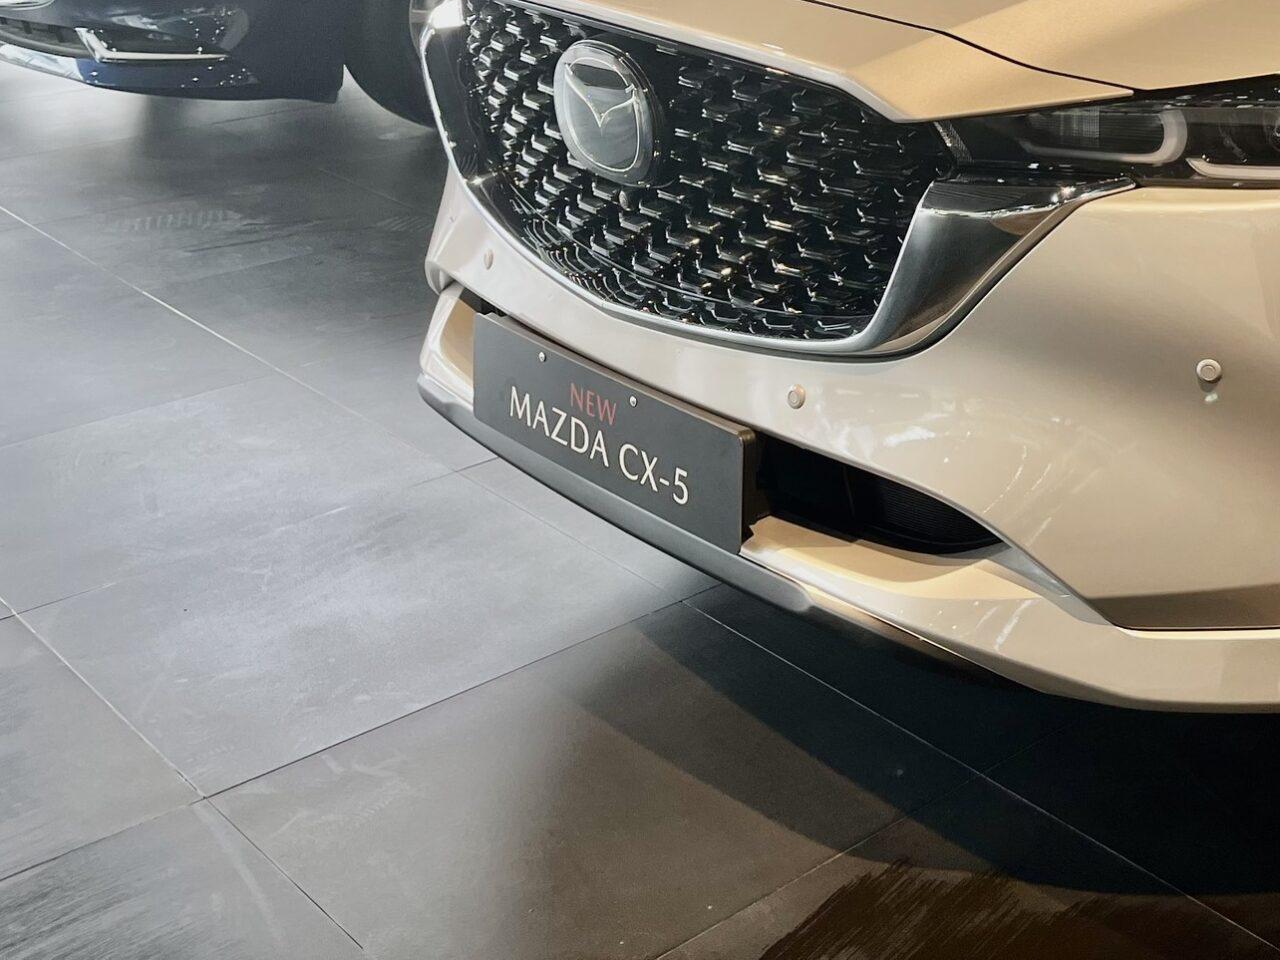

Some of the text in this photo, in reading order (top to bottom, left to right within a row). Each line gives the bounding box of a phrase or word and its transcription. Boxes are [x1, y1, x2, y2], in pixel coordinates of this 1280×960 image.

[509, 385, 690, 505] MAZDA CX-5
[569, 382, 618, 426] NEW
